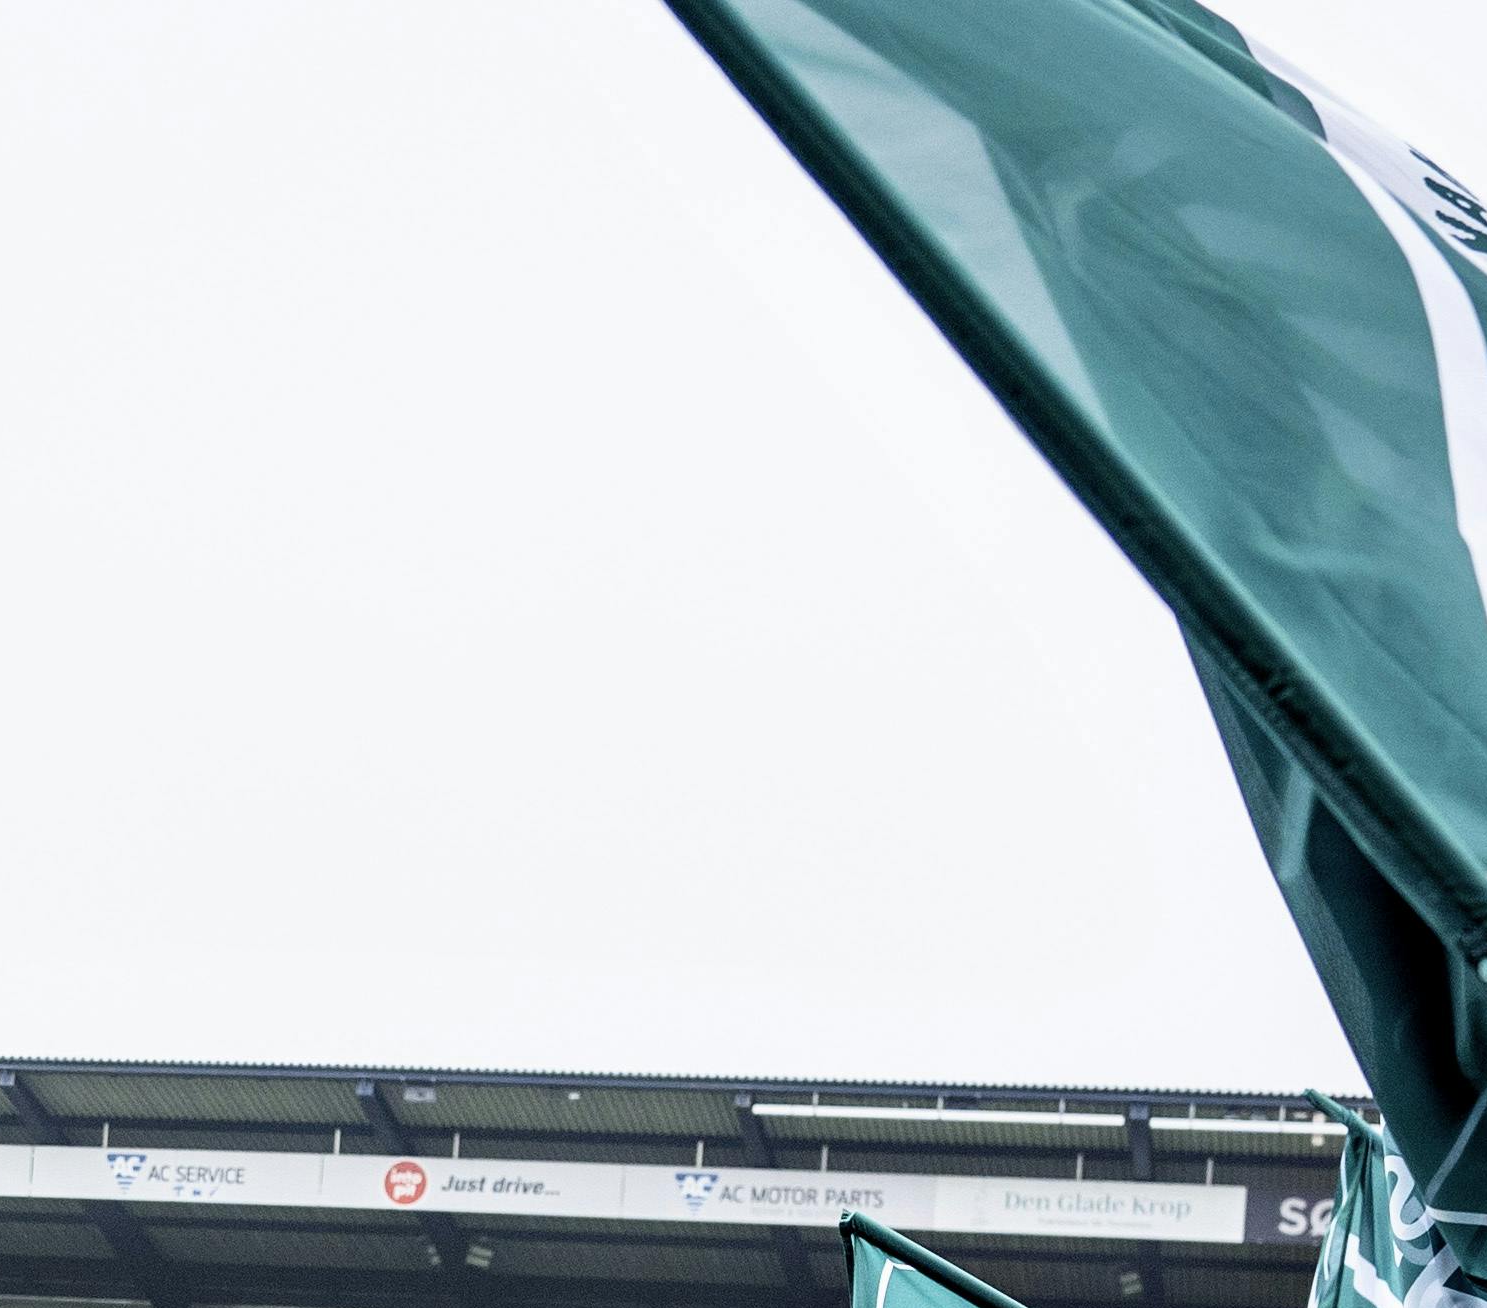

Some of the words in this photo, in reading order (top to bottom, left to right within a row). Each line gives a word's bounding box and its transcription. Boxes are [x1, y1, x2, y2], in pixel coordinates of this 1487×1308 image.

[148, 1164, 171, 1182] AC
[176, 1165, 246, 1185] SERVICE
[441, 1175, 486, 1195] Just
[720, 1186, 744, 1204] AC
[750, 1185, 818, 1206] MOTOR
[825, 1187, 884, 1208] PARTS
[1004, 1190, 1051, 1212] Den
[1057, 1193, 1124, 1215] Glade
[1132, 1194, 1192, 1221] Krop
